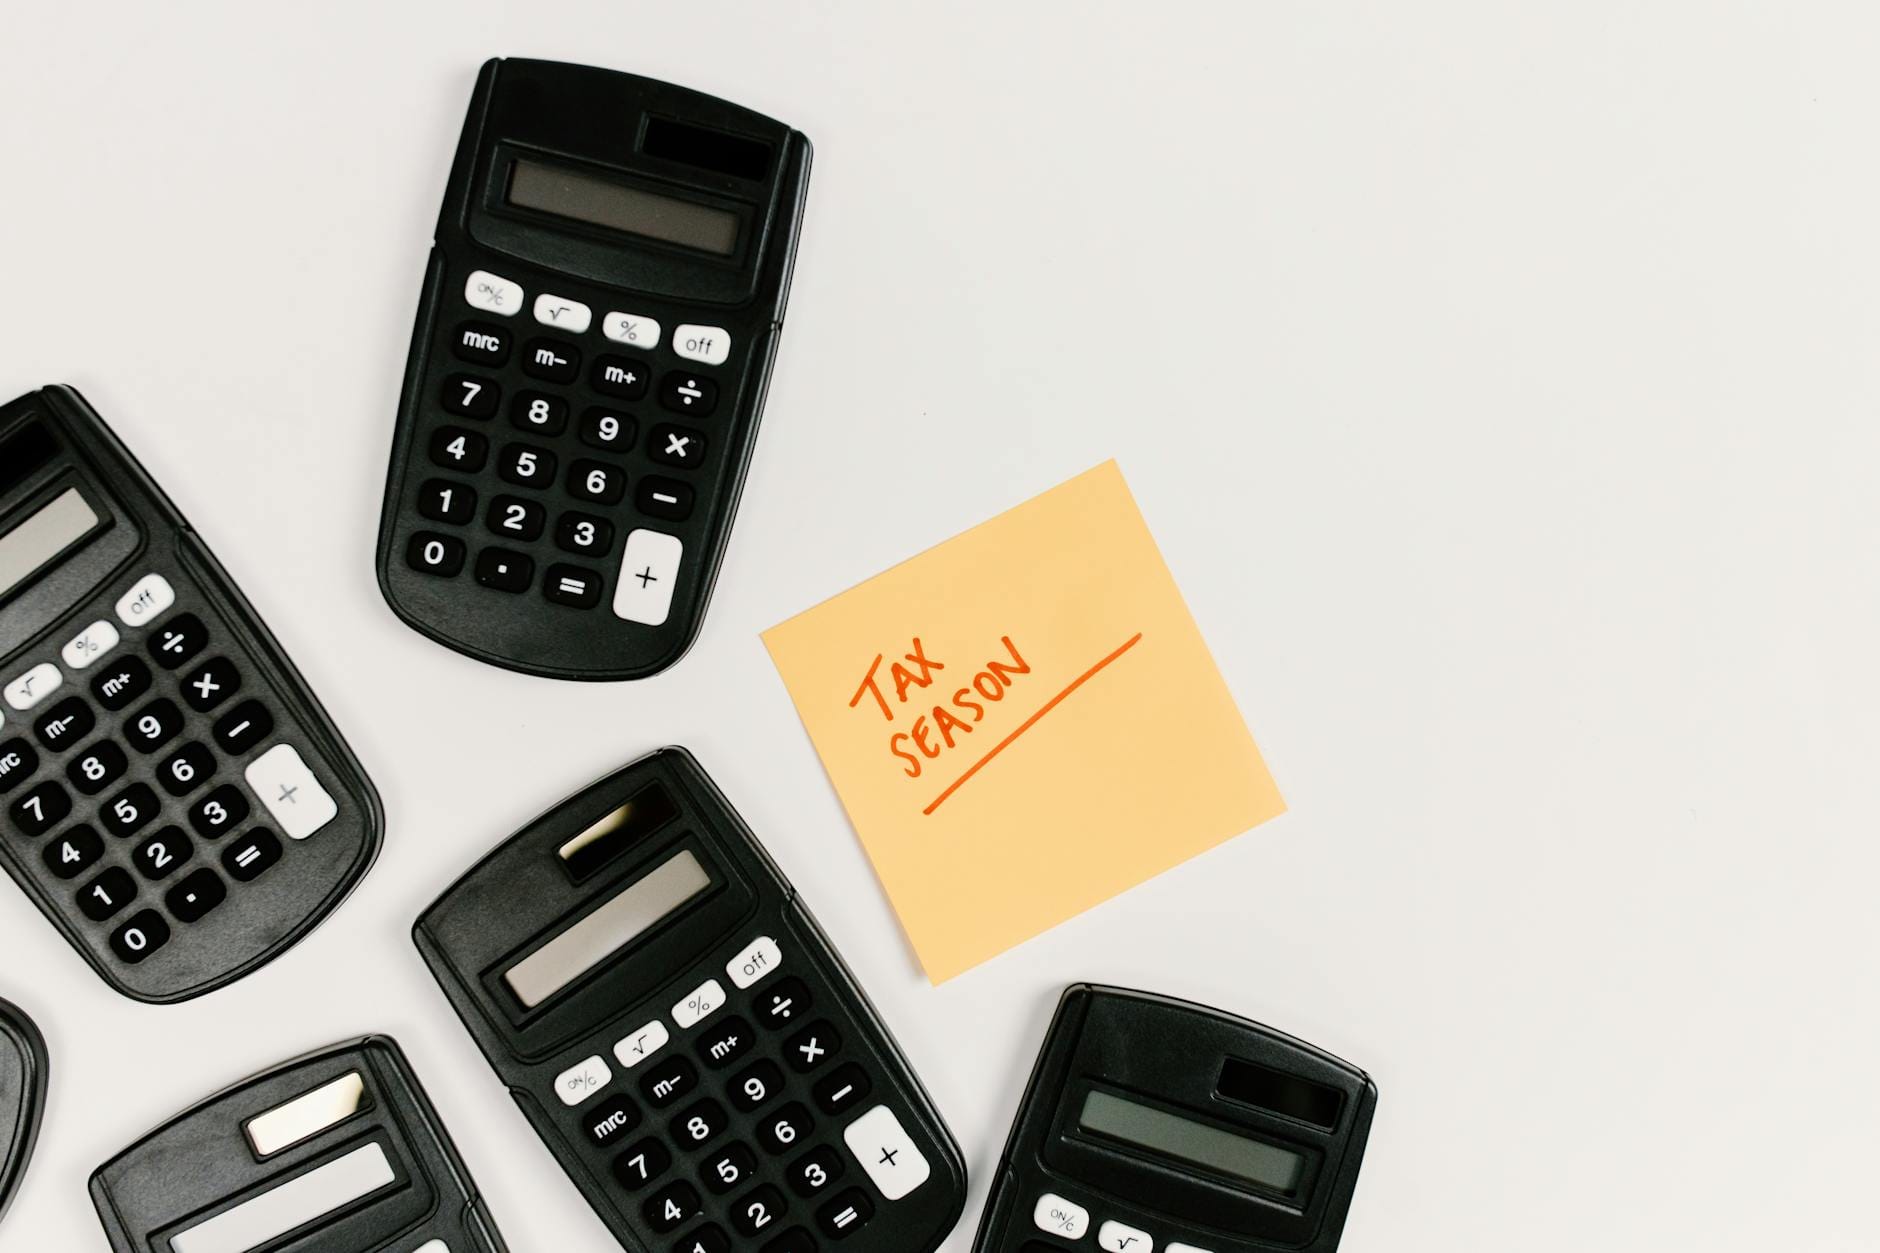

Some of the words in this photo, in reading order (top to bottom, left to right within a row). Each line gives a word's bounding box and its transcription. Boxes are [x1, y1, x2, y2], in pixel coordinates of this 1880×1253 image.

[462, 331, 500, 352] mrc
[604, 366, 637, 384] m+
[618, 320, 638, 343] %
[686, 337, 713, 355] off
[462, 381, 482, 407] 7
[528, 399, 550, 424] 8
[598, 416, 619, 441] 9
[446, 436, 466, 460] 4
[516, 452, 537, 477] 5
[586, 469, 607, 494] 6
[439, 489, 452, 513] 1
[503, 504, 526, 530] 2
[573, 521, 595, 546] 3
[424, 541, 445, 565] 0
[75, 635, 98, 657] %
[131, 588, 156, 614] off
[101, 673, 131, 697] m+
[849, 637, 945, 721] TAX
[890, 635, 1031, 778] SEASON
[22, 796, 44, 822] 7
[81, 756, 106, 781] 8
[138, 715, 162, 739] 9
[62, 841, 81, 864] 4
[113, 798, 138, 824] 5
[171, 758, 195, 782] 6
[92, 884, 113, 905] 1
[146, 842, 173, 868] 2
[203, 801, 228, 825] 3
[124, 928, 147, 951] 0
[688, 995, 711, 1016] %
[743, 951, 768, 976] off
[593, 1110, 627, 1139] mrc
[710, 1036, 738, 1060] m+
[628, 1153, 648, 1179] 7
[687, 1116, 710, 1140] 8
[744, 1077, 766, 1101] 9
[664, 1198, 682, 1221] 4
[716, 1158, 739, 1183] 5
[774, 1120, 796, 1144] 6
[747, 1202, 772, 1228] 2
[804, 1163, 827, 1187] 3
